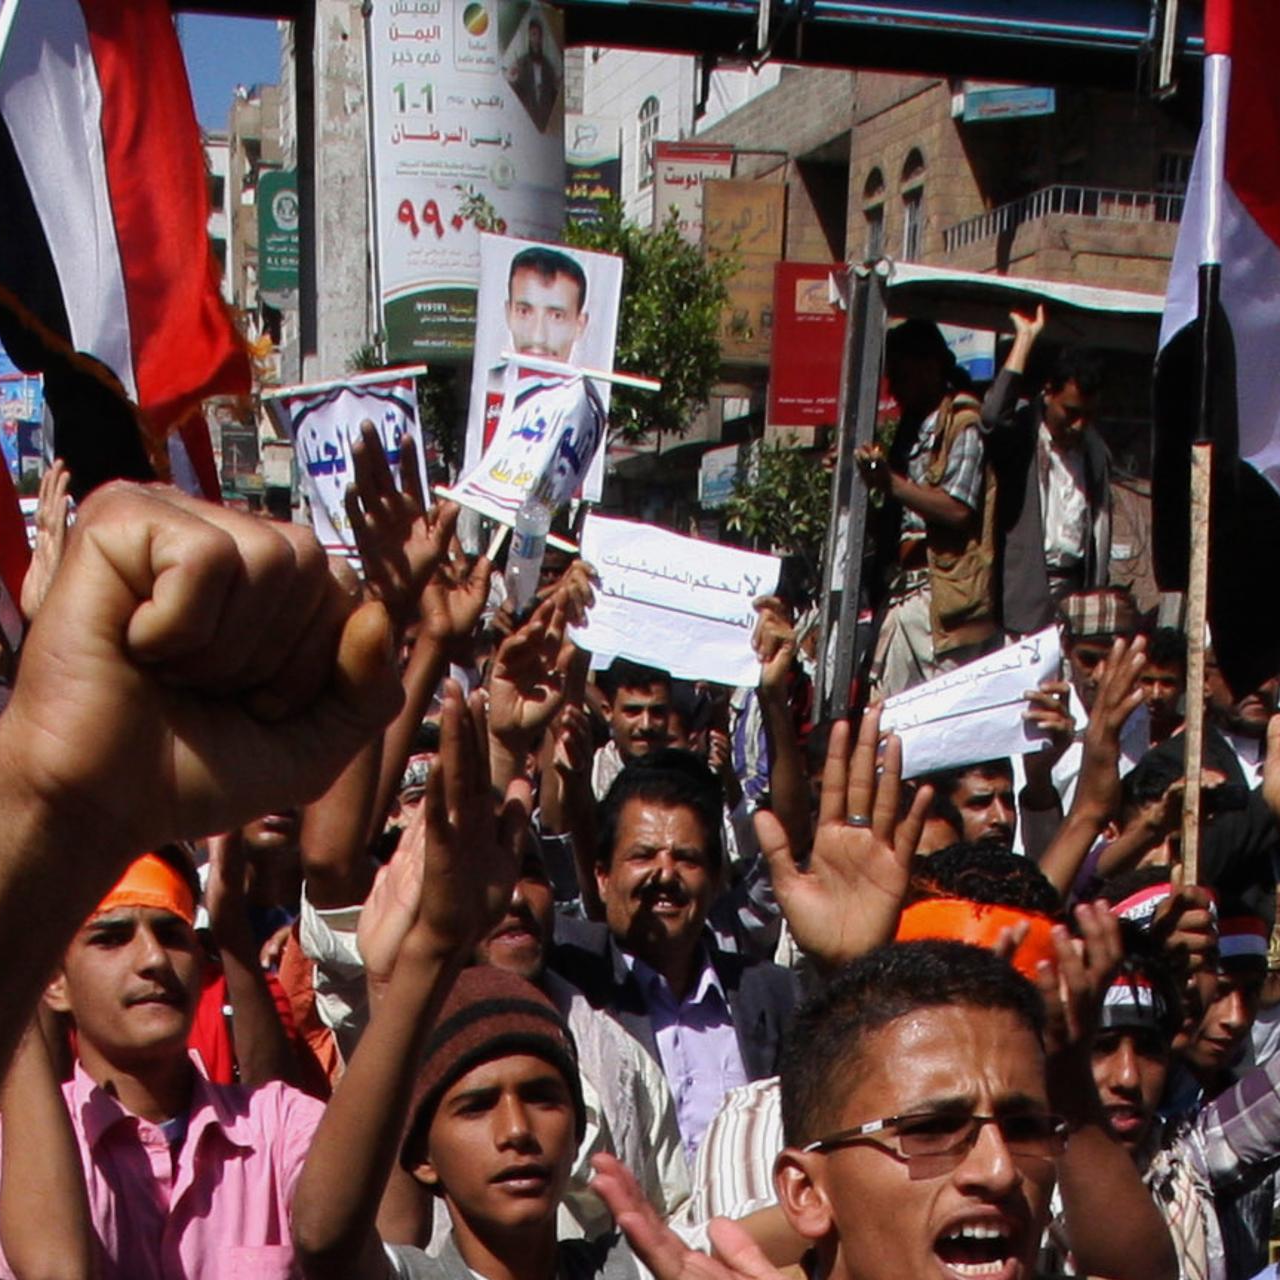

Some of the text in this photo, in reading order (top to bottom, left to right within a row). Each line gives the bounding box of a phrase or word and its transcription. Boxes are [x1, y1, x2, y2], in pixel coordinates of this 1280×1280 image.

[387, 24, 442, 42] اليمن
[390, 48, 414, 66] خير
[416, 50, 441, 66] في
[390, 124, 469, 147] السرطان
[742, 573, 762, 598] لا
[1021, 638, 1043, 665] لا
